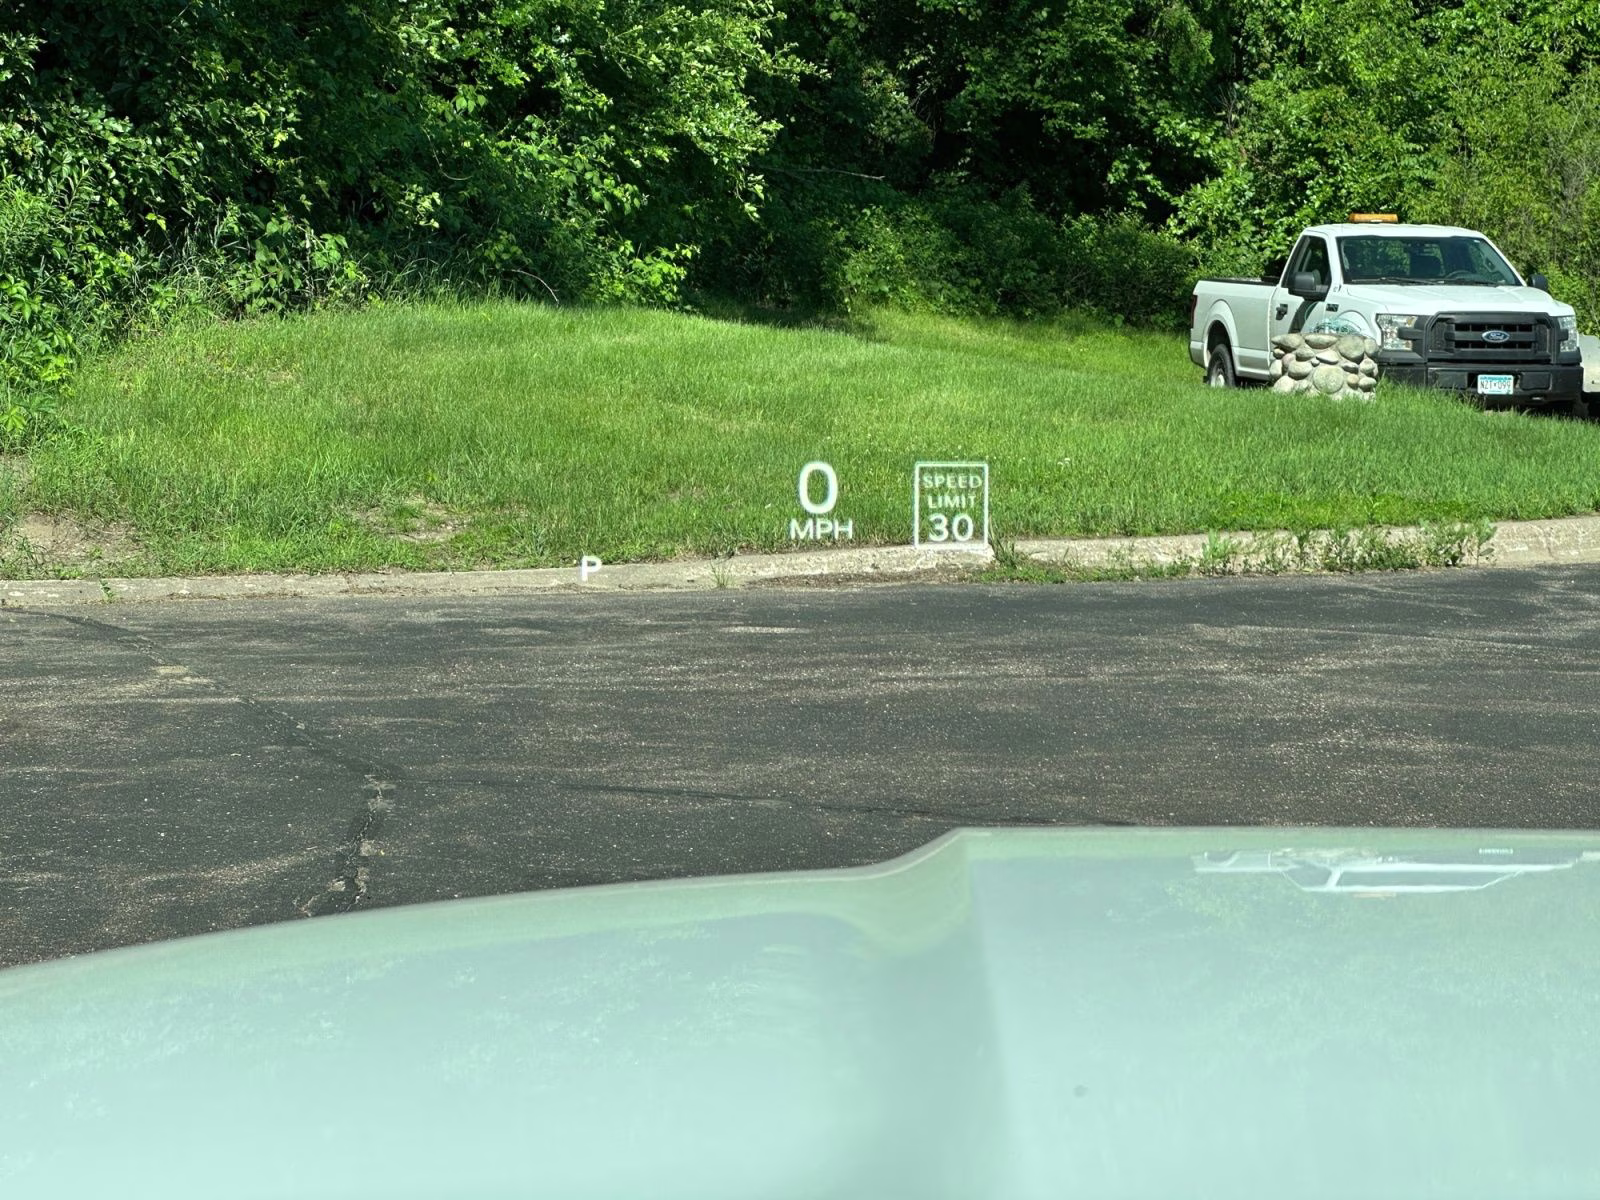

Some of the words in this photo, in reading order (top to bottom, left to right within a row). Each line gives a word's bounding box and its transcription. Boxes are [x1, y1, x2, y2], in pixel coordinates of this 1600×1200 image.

[798, 461, 838, 514] 0
[923, 473, 983, 488] SPEED
[927, 494, 976, 509] LIMIT
[789, 518, 854, 540] MPH
[928, 513, 974, 541] 30
[581, 555, 603, 582] P
